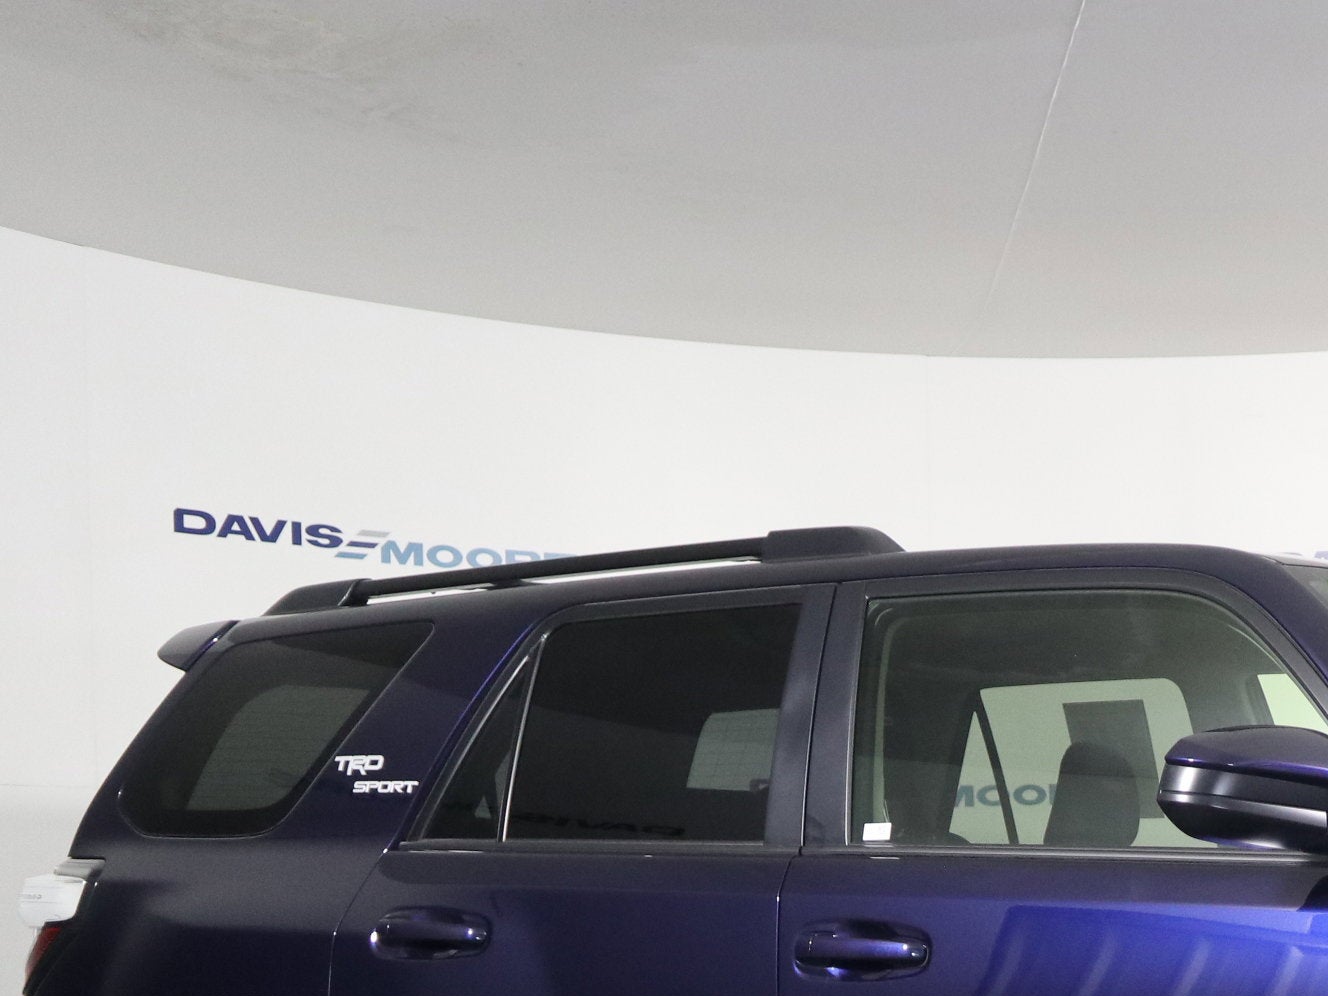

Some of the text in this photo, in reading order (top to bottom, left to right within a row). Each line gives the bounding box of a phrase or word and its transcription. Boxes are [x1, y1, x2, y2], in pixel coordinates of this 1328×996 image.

[173, 507, 578, 568] DAVIS MOOR
[335, 754, 384, 776] TRD
[353, 780, 420, 794] SPORT
